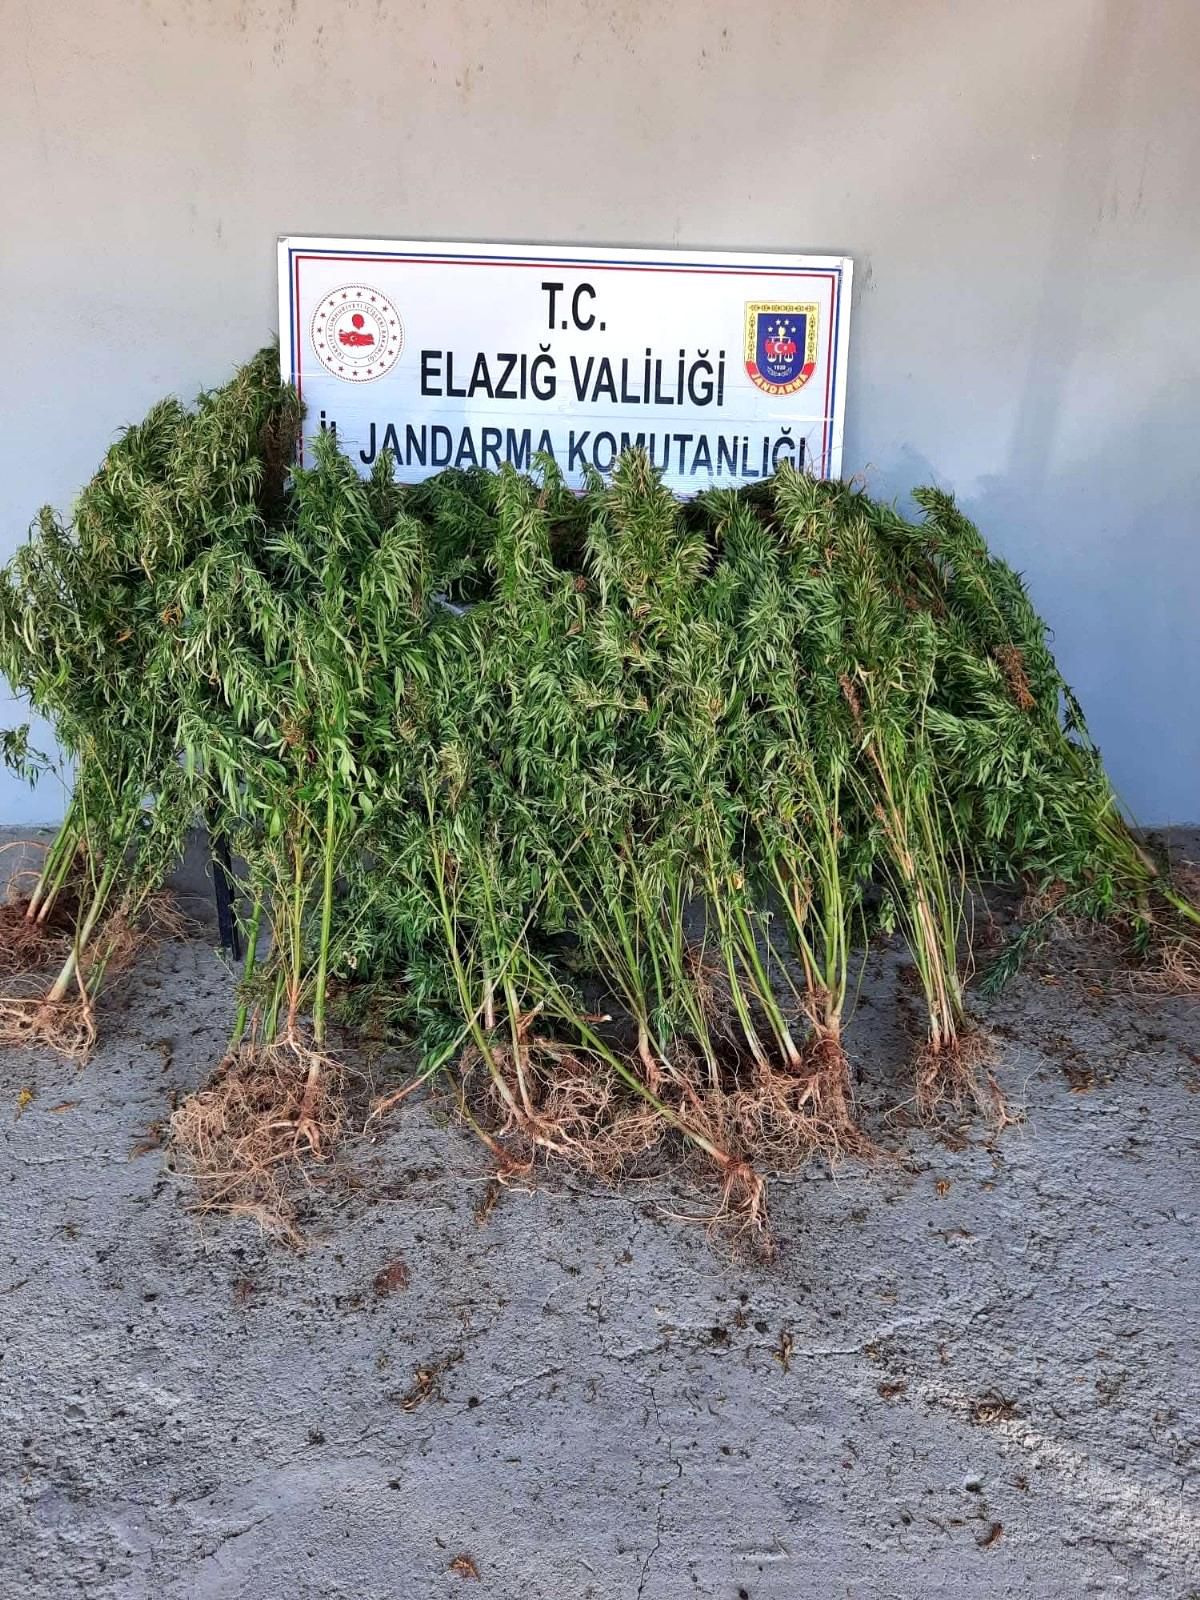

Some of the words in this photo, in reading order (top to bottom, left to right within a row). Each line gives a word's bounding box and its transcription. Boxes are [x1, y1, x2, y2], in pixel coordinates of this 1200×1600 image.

[541, 282, 606, 331] T.C.
[420, 343, 557, 401] ELAZIĞ
[570, 347, 726, 407] VALİLİĞİ
[752, 374, 809, 395] JANDARMA
[359, 422, 556, 470] JANDARMA
